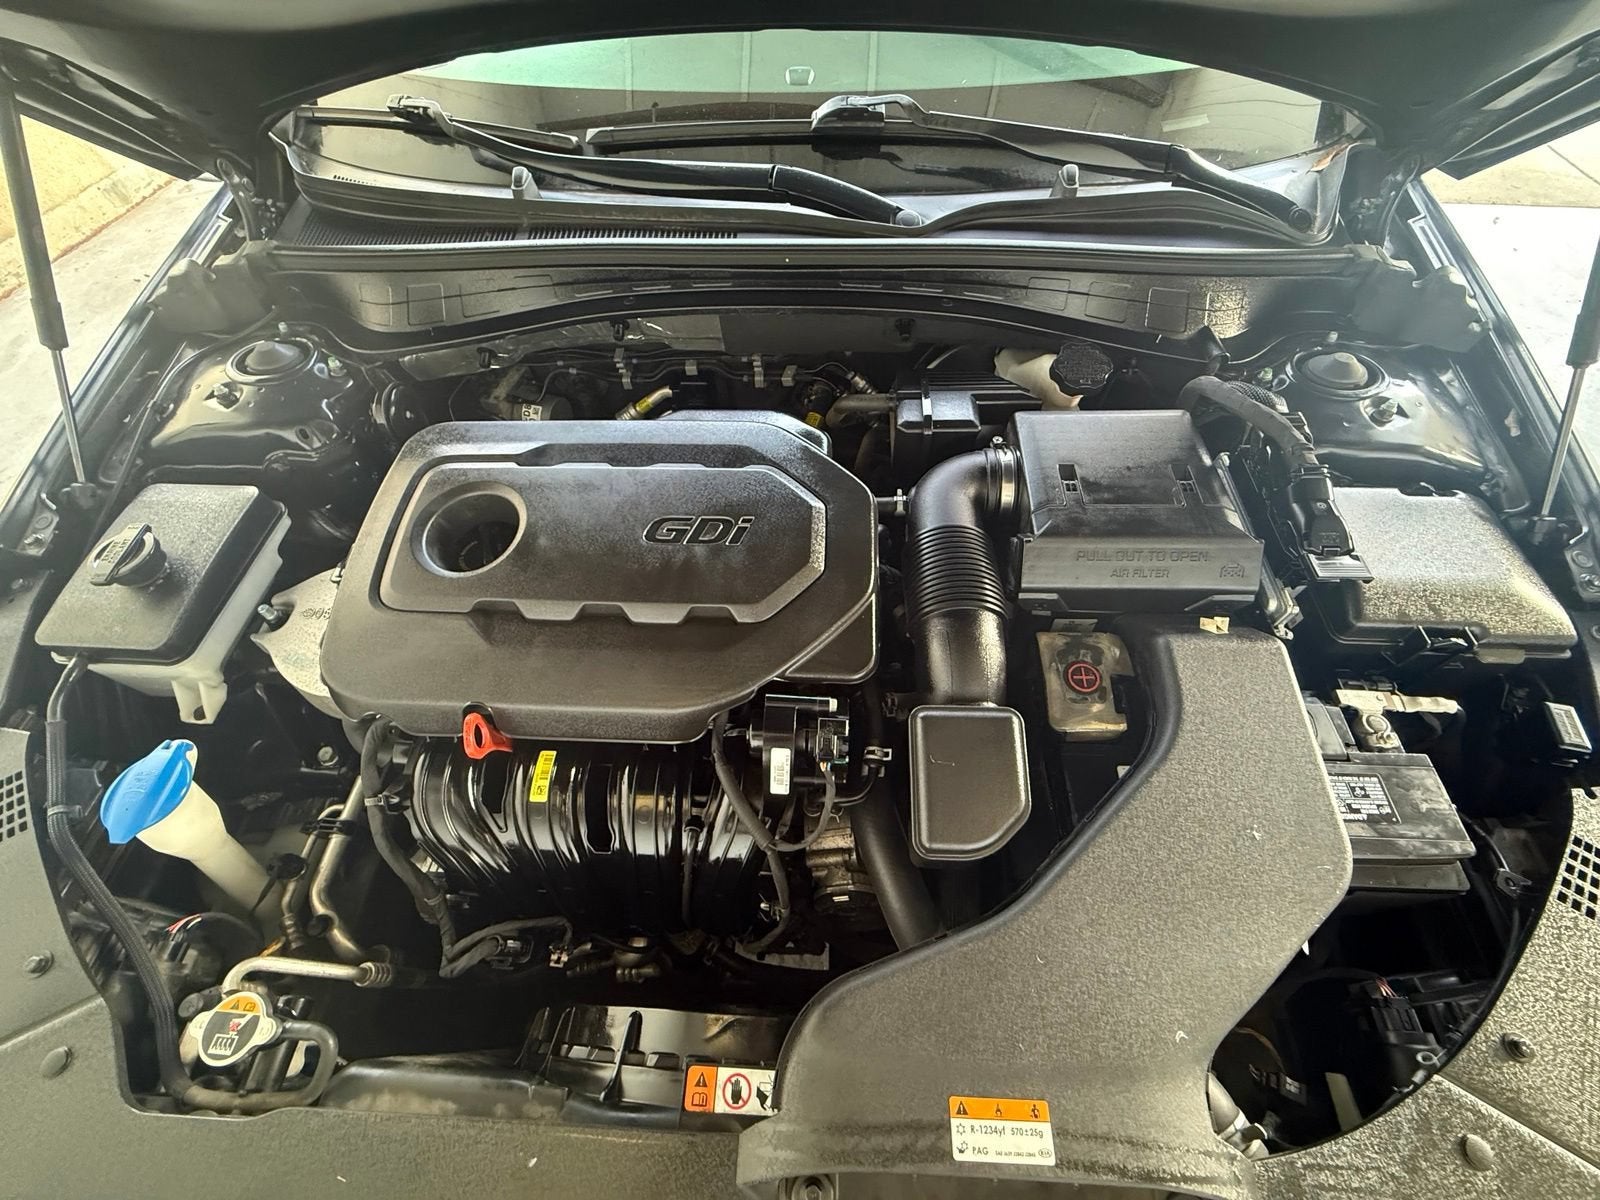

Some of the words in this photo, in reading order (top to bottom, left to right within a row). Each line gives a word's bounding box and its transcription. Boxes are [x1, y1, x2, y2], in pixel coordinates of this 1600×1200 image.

[642, 515, 755, 545] GDi
[1076, 550, 1112, 562] PULL
[1115, 550, 1144, 562] OUT
[1149, 550, 1166, 562] TO
[1170, 550, 1209, 562] OPEN
[1110, 568, 1129, 578] AIR
[1131, 568, 1170, 578] FILTER
[1010, 1127, 1044, 1138] 570±25g
[972, 1146, 989, 1156] PAG
